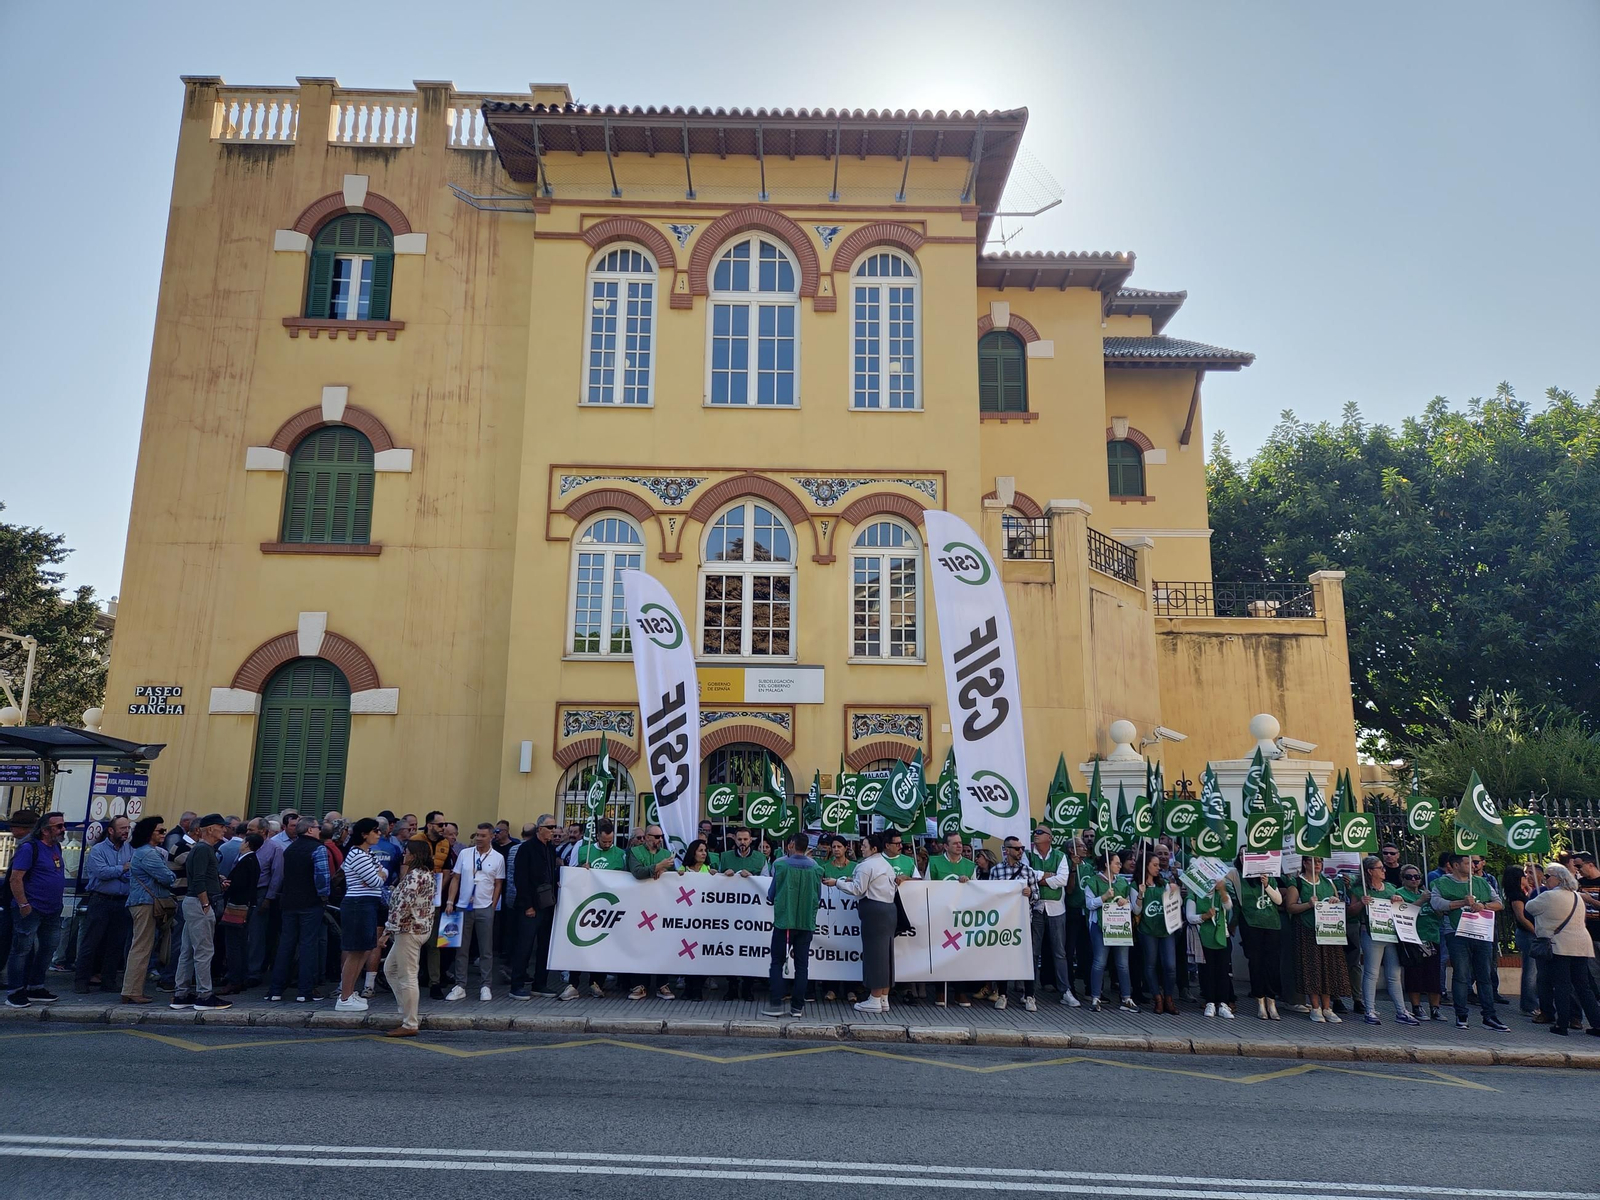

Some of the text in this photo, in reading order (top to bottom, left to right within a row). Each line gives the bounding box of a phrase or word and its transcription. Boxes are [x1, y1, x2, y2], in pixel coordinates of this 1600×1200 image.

[136, 687, 181, 697] PASEO
[149, 696, 165, 705] DE
[129, 704, 184, 715] SANCHA
[898, 773, 915, 800] CSIF
[713, 794, 735, 805] CSIF
[862, 790, 880, 802] CSI
[95, 801, 103, 815] 3
[128, 800, 142, 814] 32
[753, 804, 777, 816] CSIF
[829, 807, 853, 819] CSIF
[1060, 804, 1084, 816] CSIF
[1172, 812, 1199, 824] CSIF
[1414, 809, 1437, 822] CSIF
[87, 826, 102, 840] 33
[1255, 826, 1280, 838] CSIF
[1348, 826, 1372, 838] CSIF
[1513, 828, 1543, 840] CSIF
[1100, 840, 1126, 853] CSIF
[701, 891, 761, 906] ¡SUBIDA
[578, 908, 626, 929] CSIF
[662, 917, 729, 931] MEJORES
[952, 909, 1000, 928] TODO
[965, 928, 1022, 948] TOD@S
[702, 941, 734, 957] MÁS
[808, 946, 863, 962] PÚBLIC
